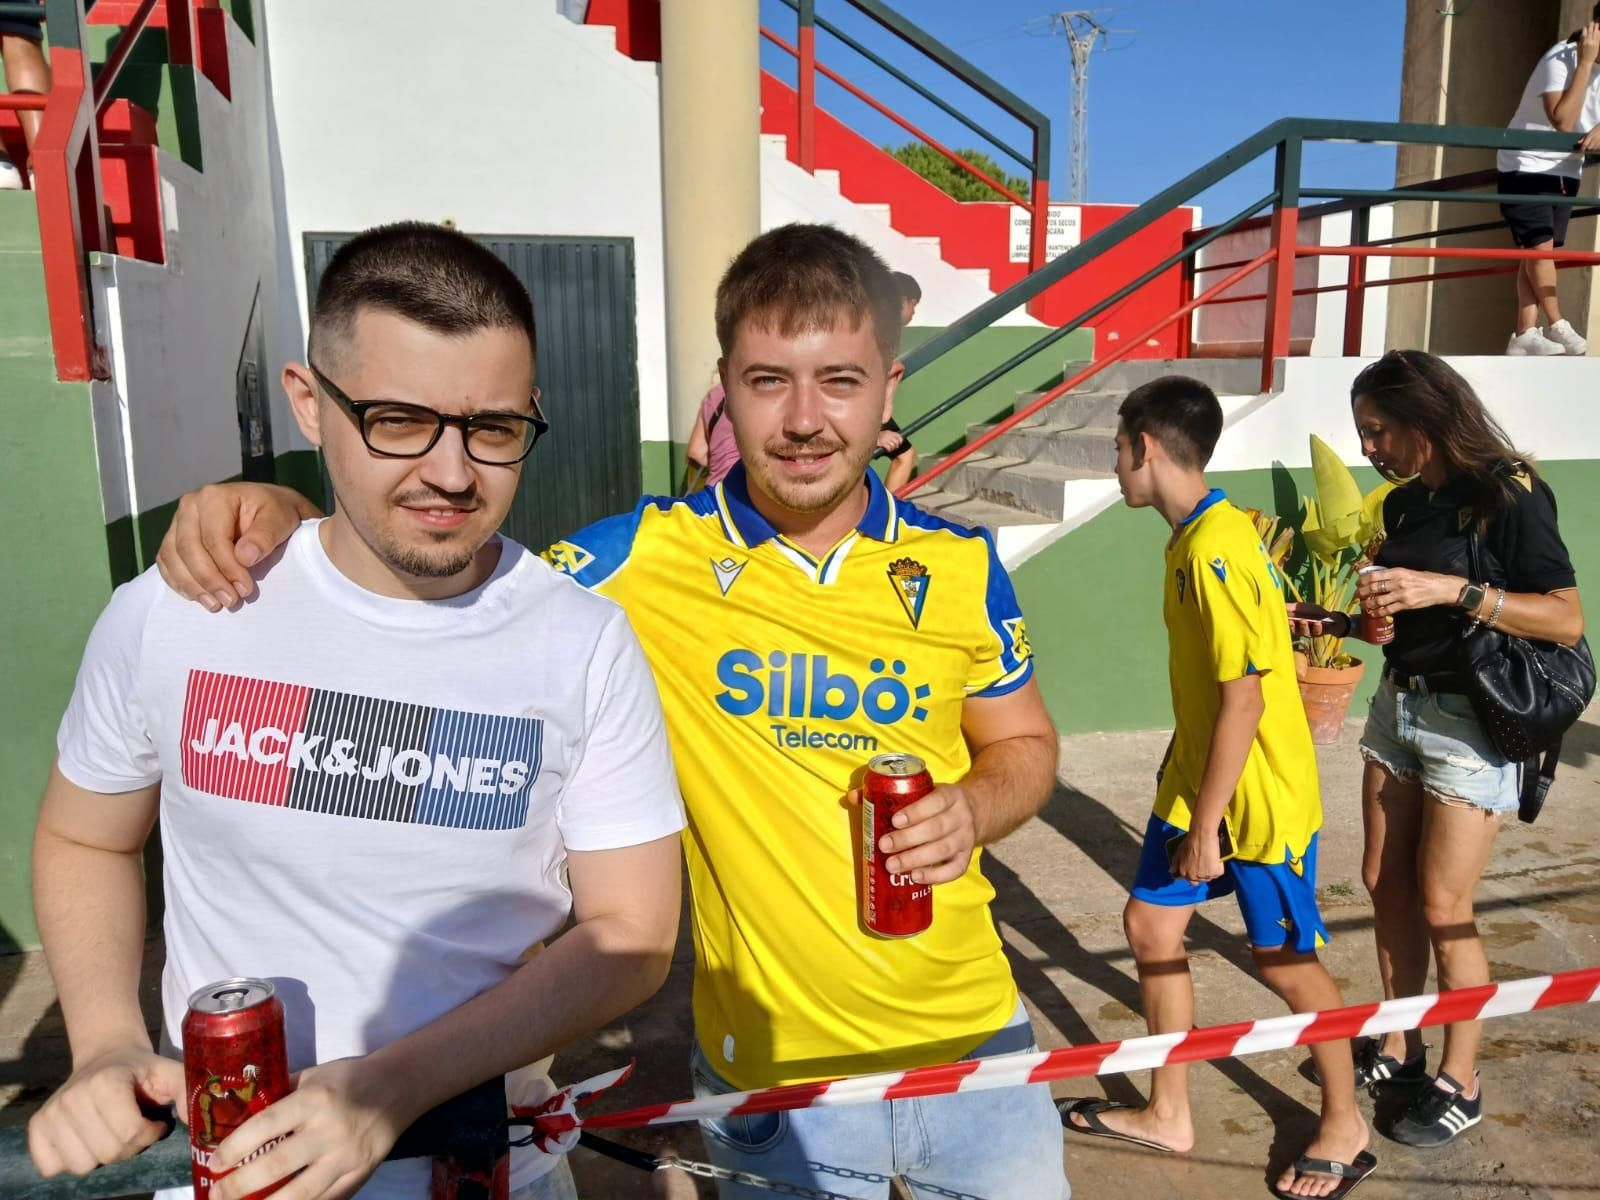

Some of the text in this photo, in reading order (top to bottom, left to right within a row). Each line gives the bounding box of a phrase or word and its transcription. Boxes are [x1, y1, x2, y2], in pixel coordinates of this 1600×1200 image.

[1058, 218, 1077, 227] SECOS
[769, 724, 879, 752] Telecom
[190, 718, 530, 796] JACK&JONES
